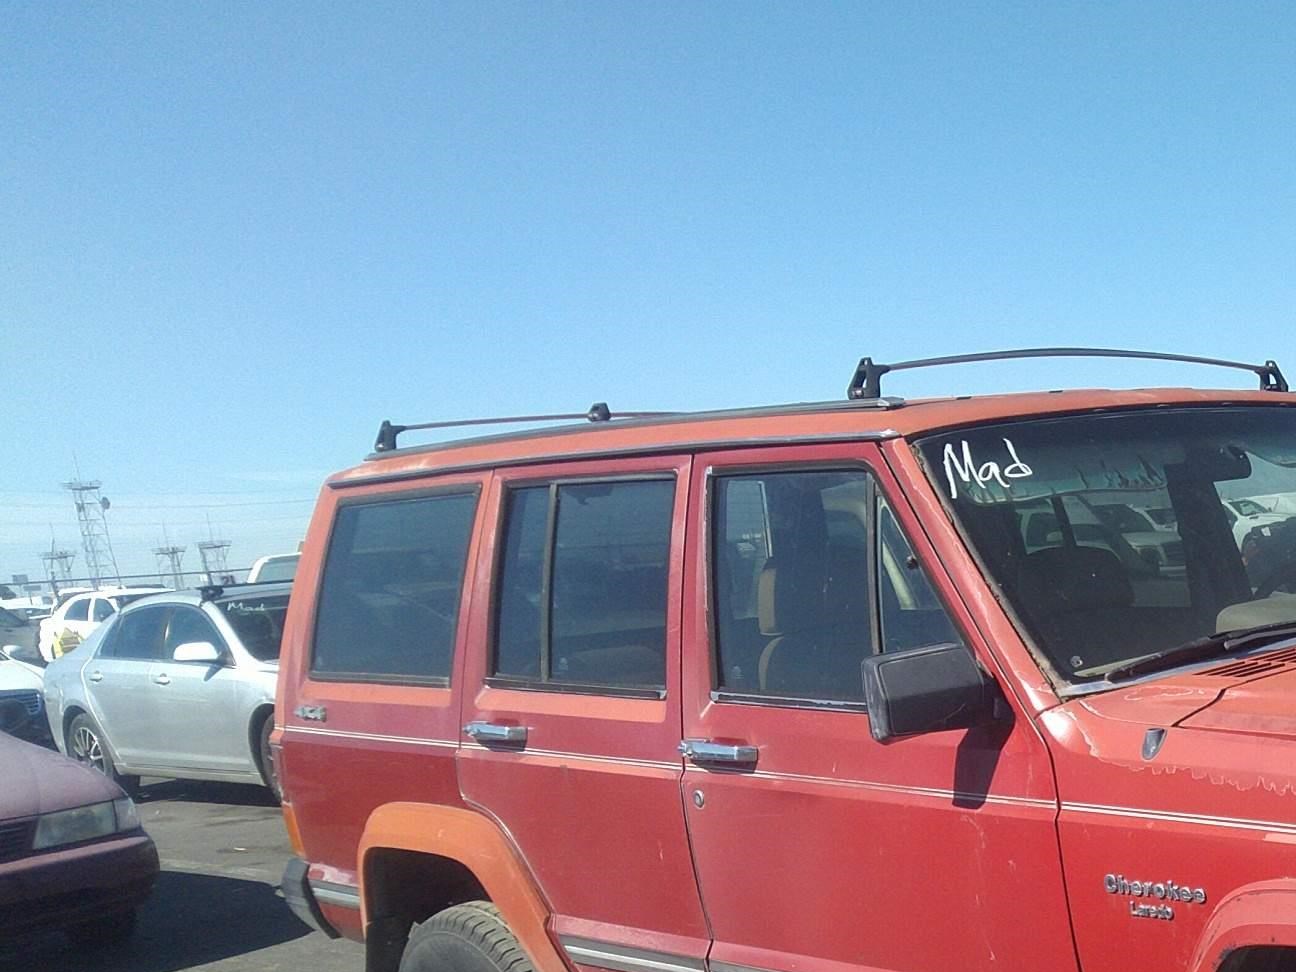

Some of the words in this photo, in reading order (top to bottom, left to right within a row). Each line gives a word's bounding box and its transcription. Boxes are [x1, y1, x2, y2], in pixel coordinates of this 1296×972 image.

[943, 438, 1033, 499] Mad
[1104, 873, 1207, 904] Cherokee
[1129, 901, 1175, 920] Laredo
